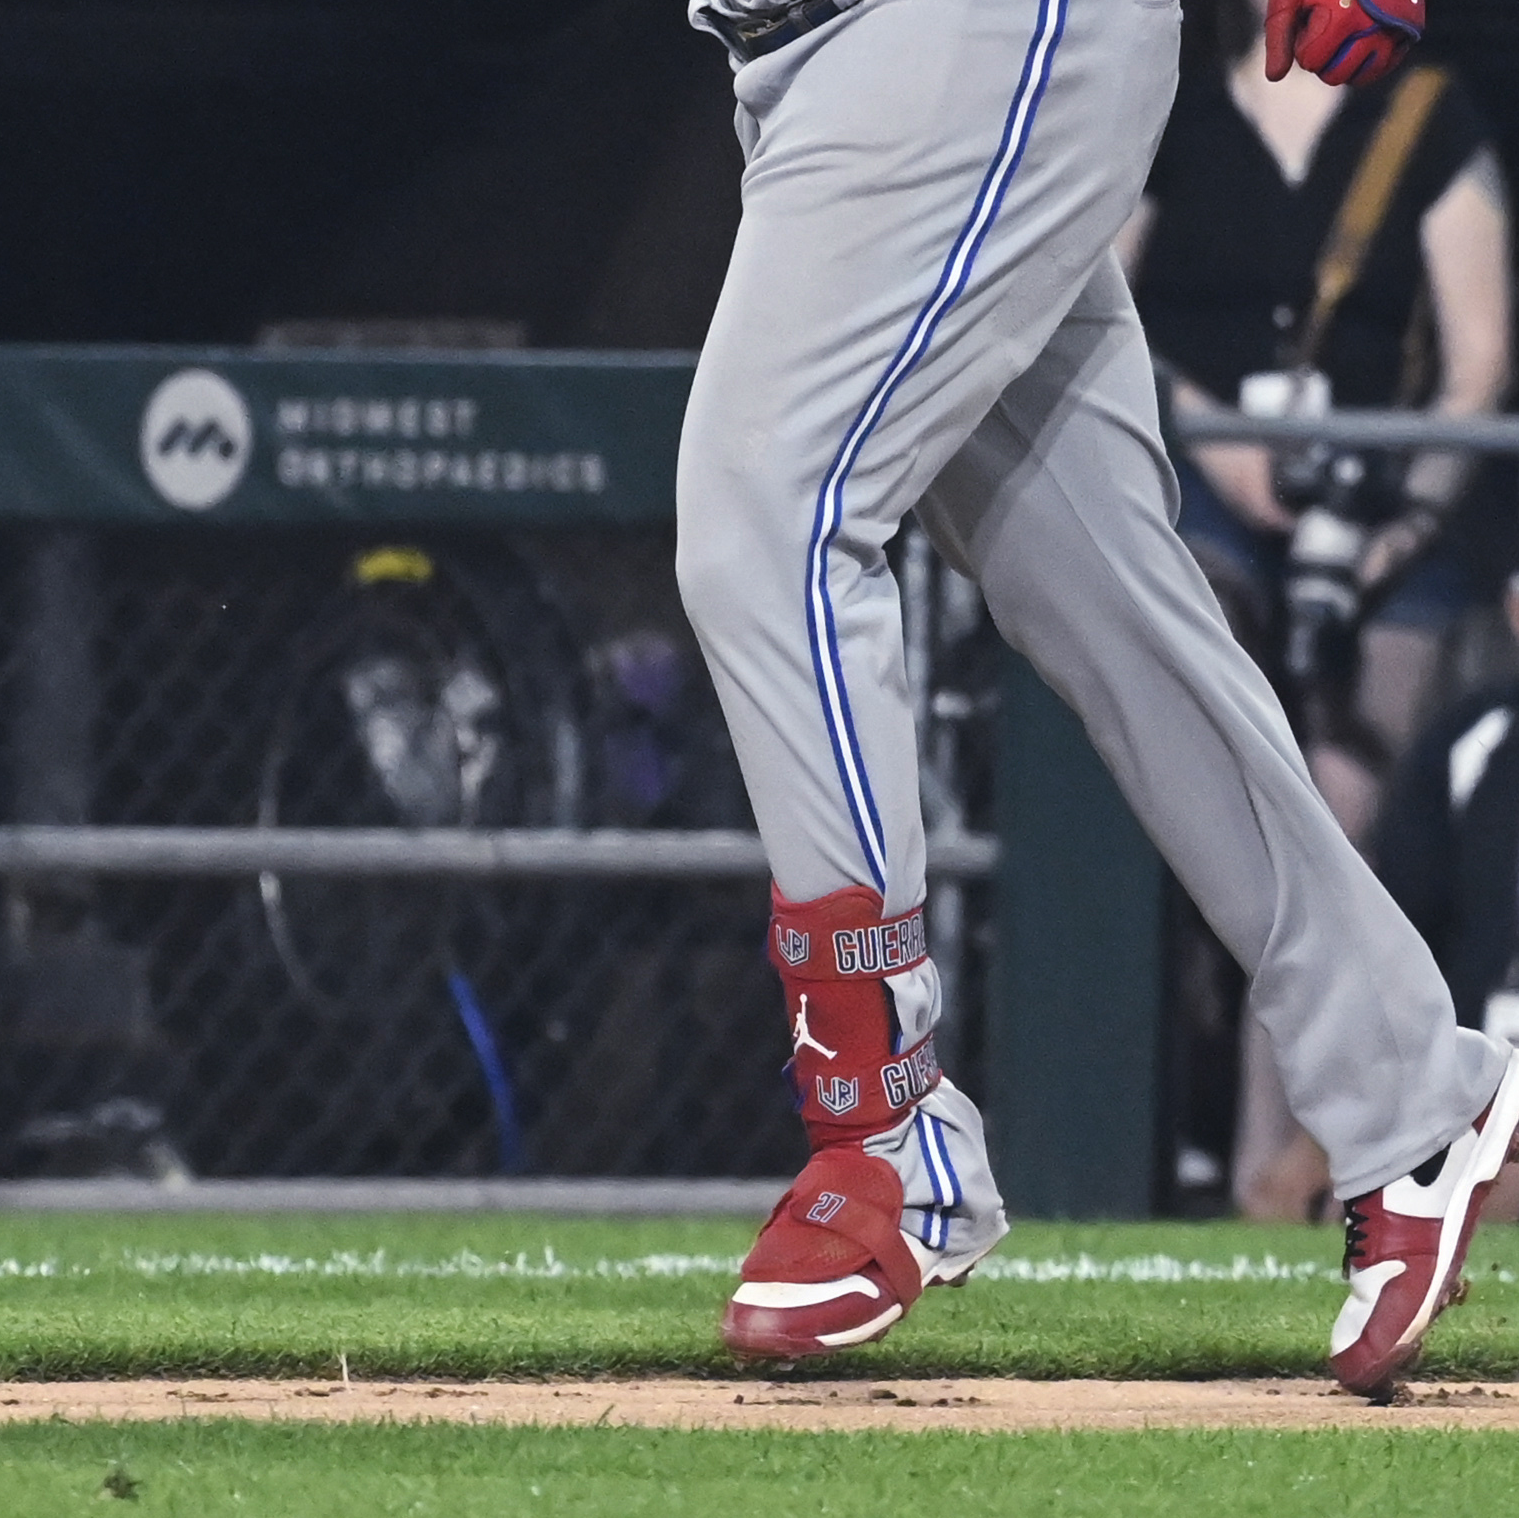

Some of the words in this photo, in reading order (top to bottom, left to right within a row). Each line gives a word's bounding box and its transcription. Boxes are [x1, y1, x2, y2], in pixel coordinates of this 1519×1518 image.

[276, 398, 478, 437] MIDWEST
[278, 449, 608, 493] ORTHOPAEDICS
[806, 1191, 848, 1224] 27
